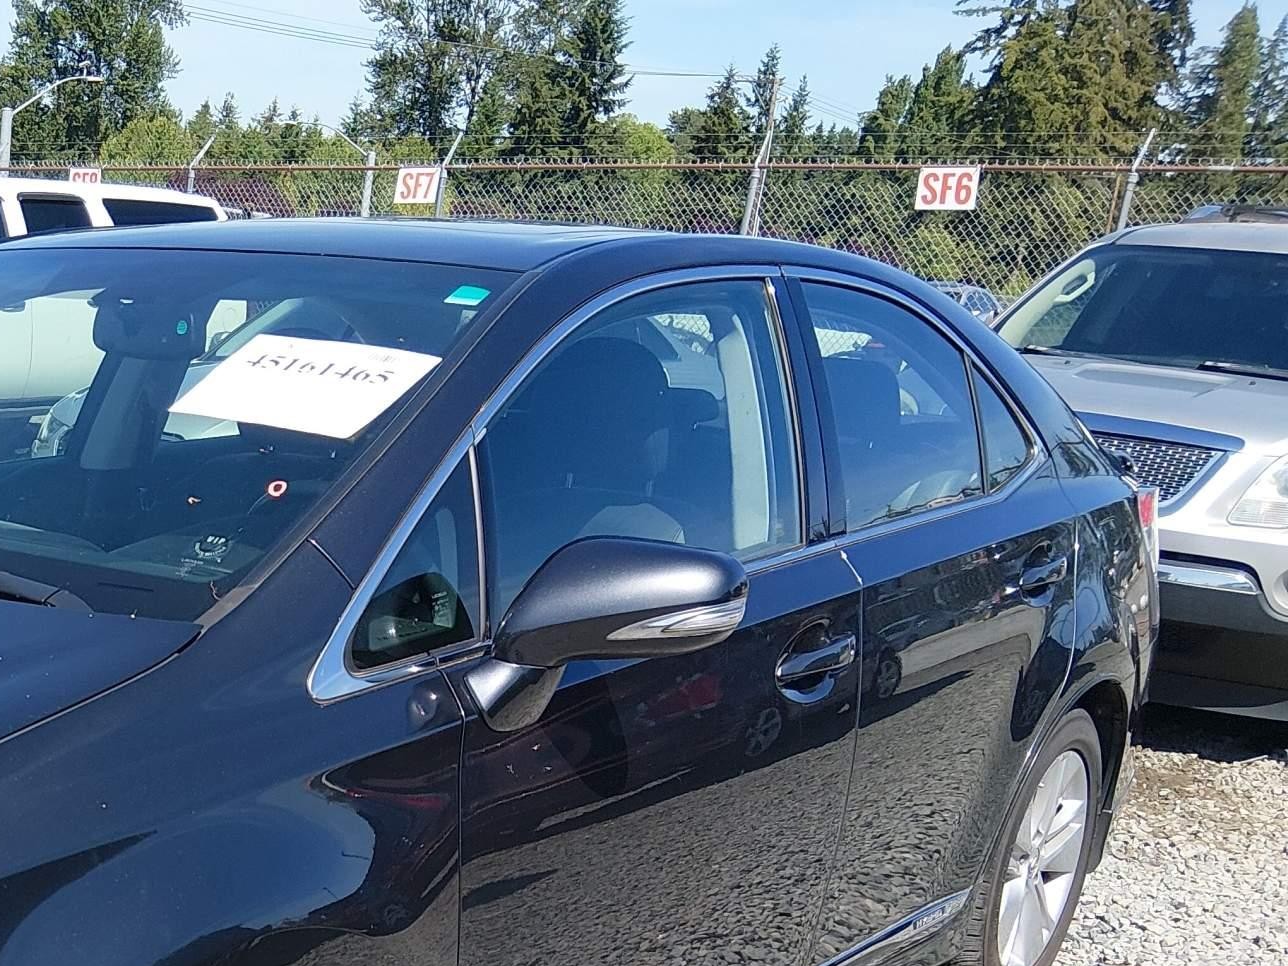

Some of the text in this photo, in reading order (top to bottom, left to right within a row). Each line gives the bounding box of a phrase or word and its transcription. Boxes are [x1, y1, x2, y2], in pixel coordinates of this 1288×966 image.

[400, 172, 435, 199] SF7
[921, 172, 973, 205] SF6
[247, 353, 395, 384] 45161465
